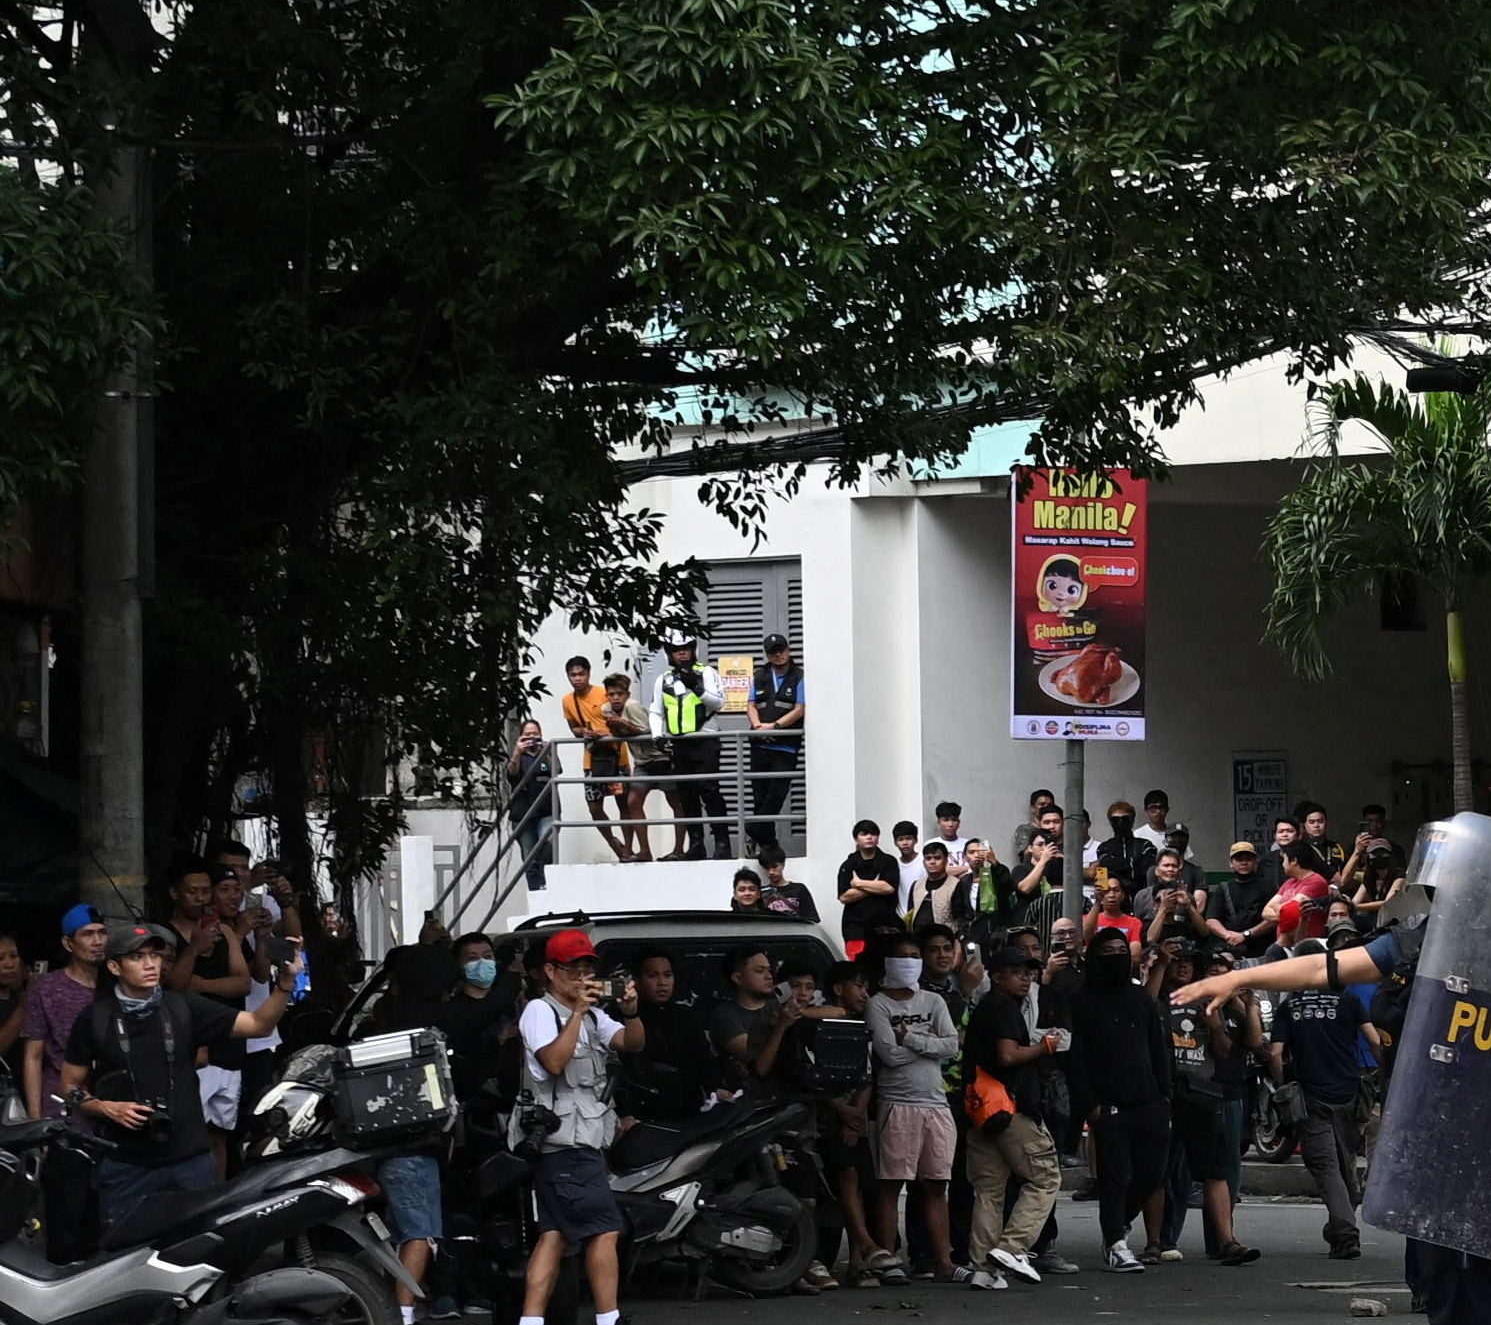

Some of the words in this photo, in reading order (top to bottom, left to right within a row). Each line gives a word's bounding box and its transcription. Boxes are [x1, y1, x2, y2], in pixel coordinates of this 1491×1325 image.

[1033, 500, 1137, 535] Manila!
[1034, 622, 1075, 641] Chooks
[1083, 620, 1097, 635] Go
[1237, 764, 1252, 791] 15
[1256, 777, 1285, 790] PARKING
[1238, 798, 1283, 812] DROP-OFF
[1255, 814, 1268, 827] OR
[1243, 829, 1265, 843] PICK
[1267, 830, 1276, 843] U
